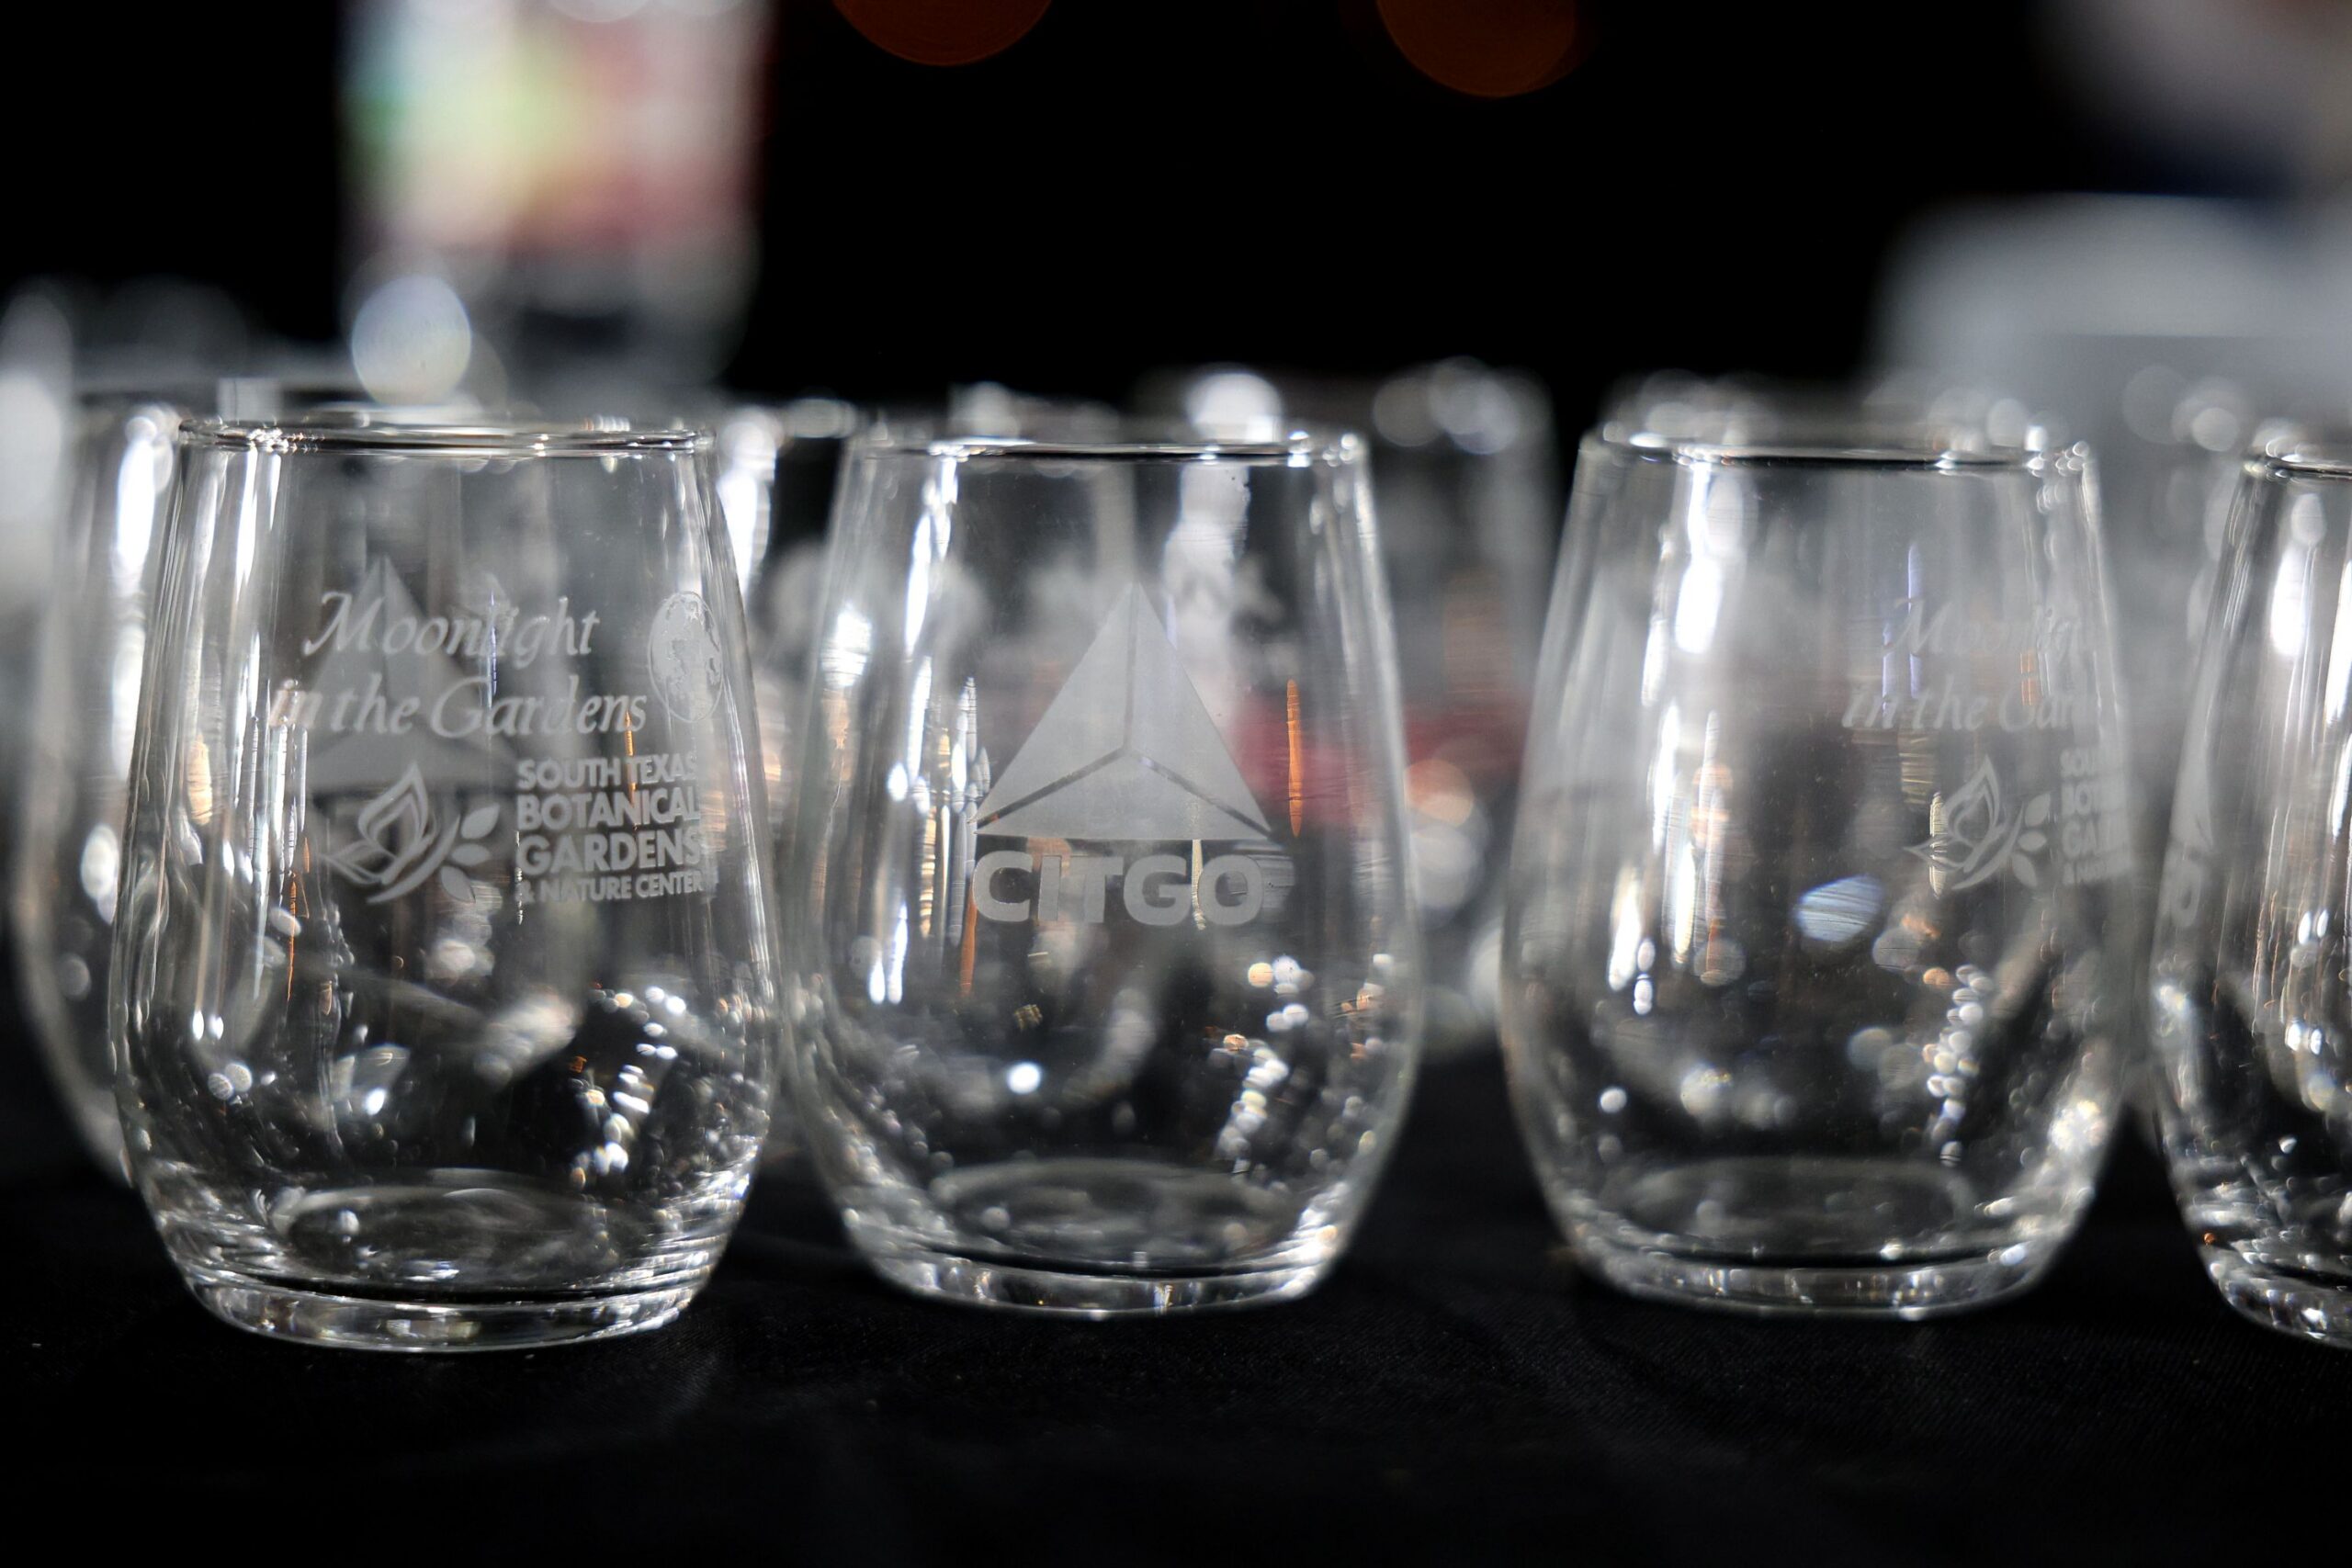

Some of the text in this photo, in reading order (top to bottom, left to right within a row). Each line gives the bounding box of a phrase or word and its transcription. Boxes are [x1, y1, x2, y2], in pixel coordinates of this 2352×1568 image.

[304, 591, 600, 670] Moonlight
[267, 671, 648, 739] in the Gardens
[516, 752, 700, 791] SOUTH TEXAS
[516, 785, 701, 831] BOTANICAL
[515, 828, 702, 876] GARDENS
[539, 874, 632, 903] NATURE
[635, 870, 705, 898] CENTER
[971, 850, 1265, 927] CITGO
